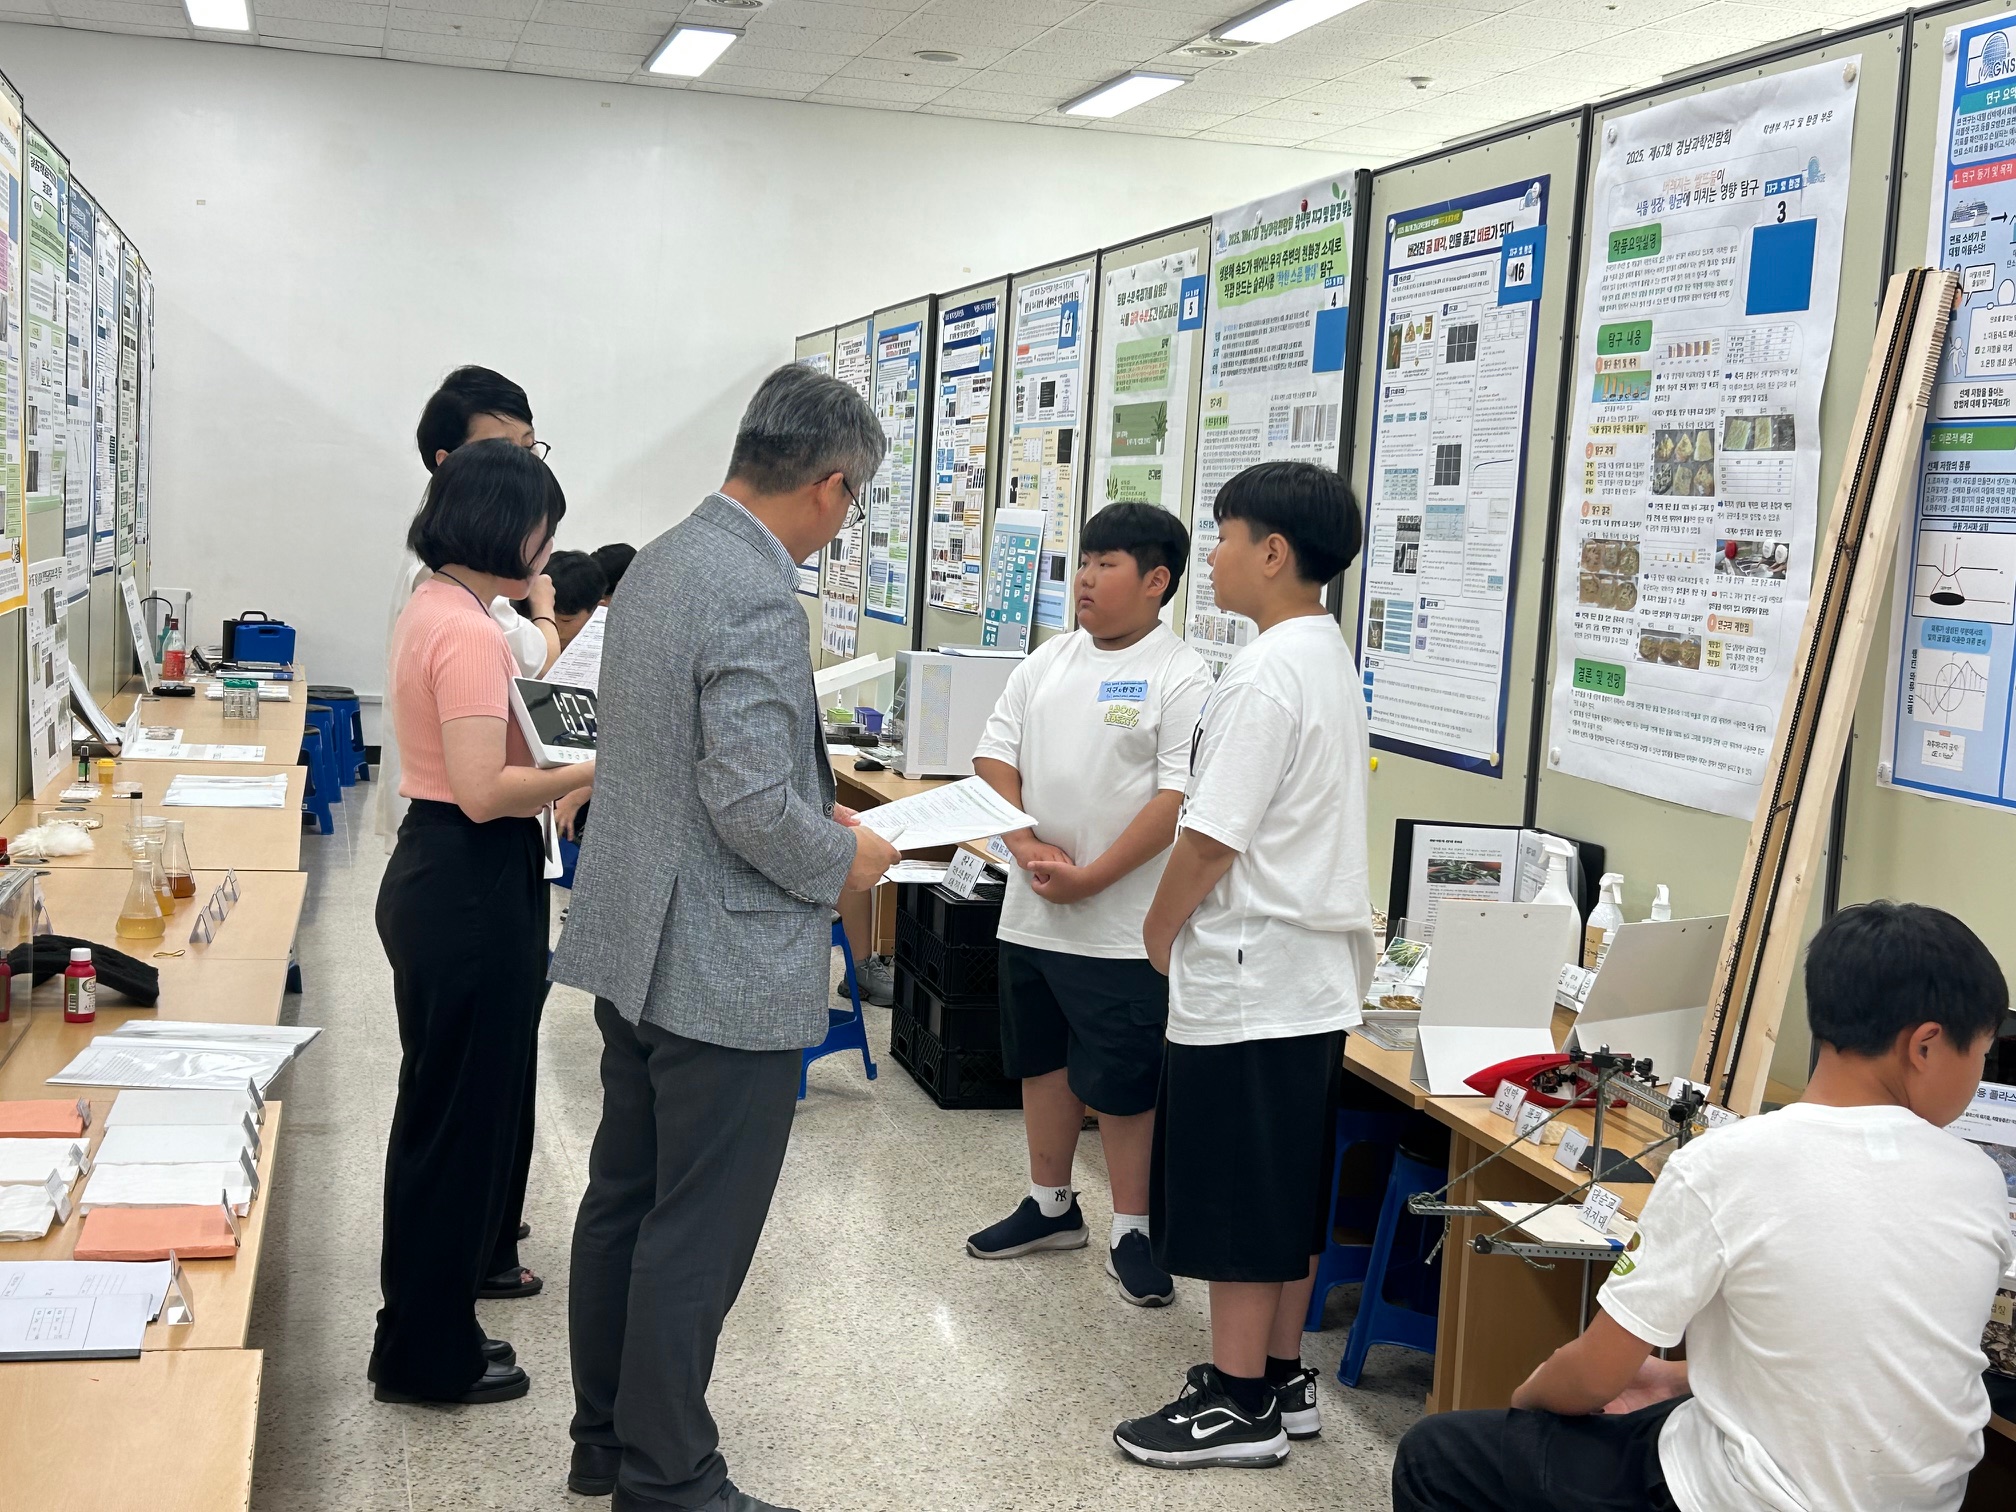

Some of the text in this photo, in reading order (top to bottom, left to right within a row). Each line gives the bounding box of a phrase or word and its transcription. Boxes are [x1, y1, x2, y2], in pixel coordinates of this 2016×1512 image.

[1986, 90, 2000, 105] 연구
[1626, 128, 1732, 165] 2025. 제67회 경남과학전람회
[1962, 170, 1975, 183] 연구
[1977, 168, 1990, 180] 동기
[1766, 183, 1778, 194] 지구
[1637, 201, 1649, 216] 식물
[1669, 190, 1691, 210] 항균에
[1694, 185, 1717, 204] 미치는
[1720, 182, 1737, 200] 영향
[1741, 179, 1759, 197] 탐구
[1777, 201, 1786, 223] 3
[1477, 224, 1498, 243] 비료가
[1949, 234, 1961, 245] 연료
[1321, 237, 1341, 256] 소재로
[1320, 260, 1334, 279] 탐구
[1514, 263, 1525, 282] 16
[1331, 291, 1337, 307] 4
[1188, 301, 1194, 315] 5
[1608, 329, 1641, 348] 탐구 내용
[1939, 432, 1958, 445] 이론적
[1960, 432, 1974, 444] 배경
[1927, 460, 1971, 471] 선체 저항의 종류
[1607, 672, 1621, 689] 전망
[1504, 1085, 1519, 1100] 선박
[1055, 1189, 1067, 1202] NY
